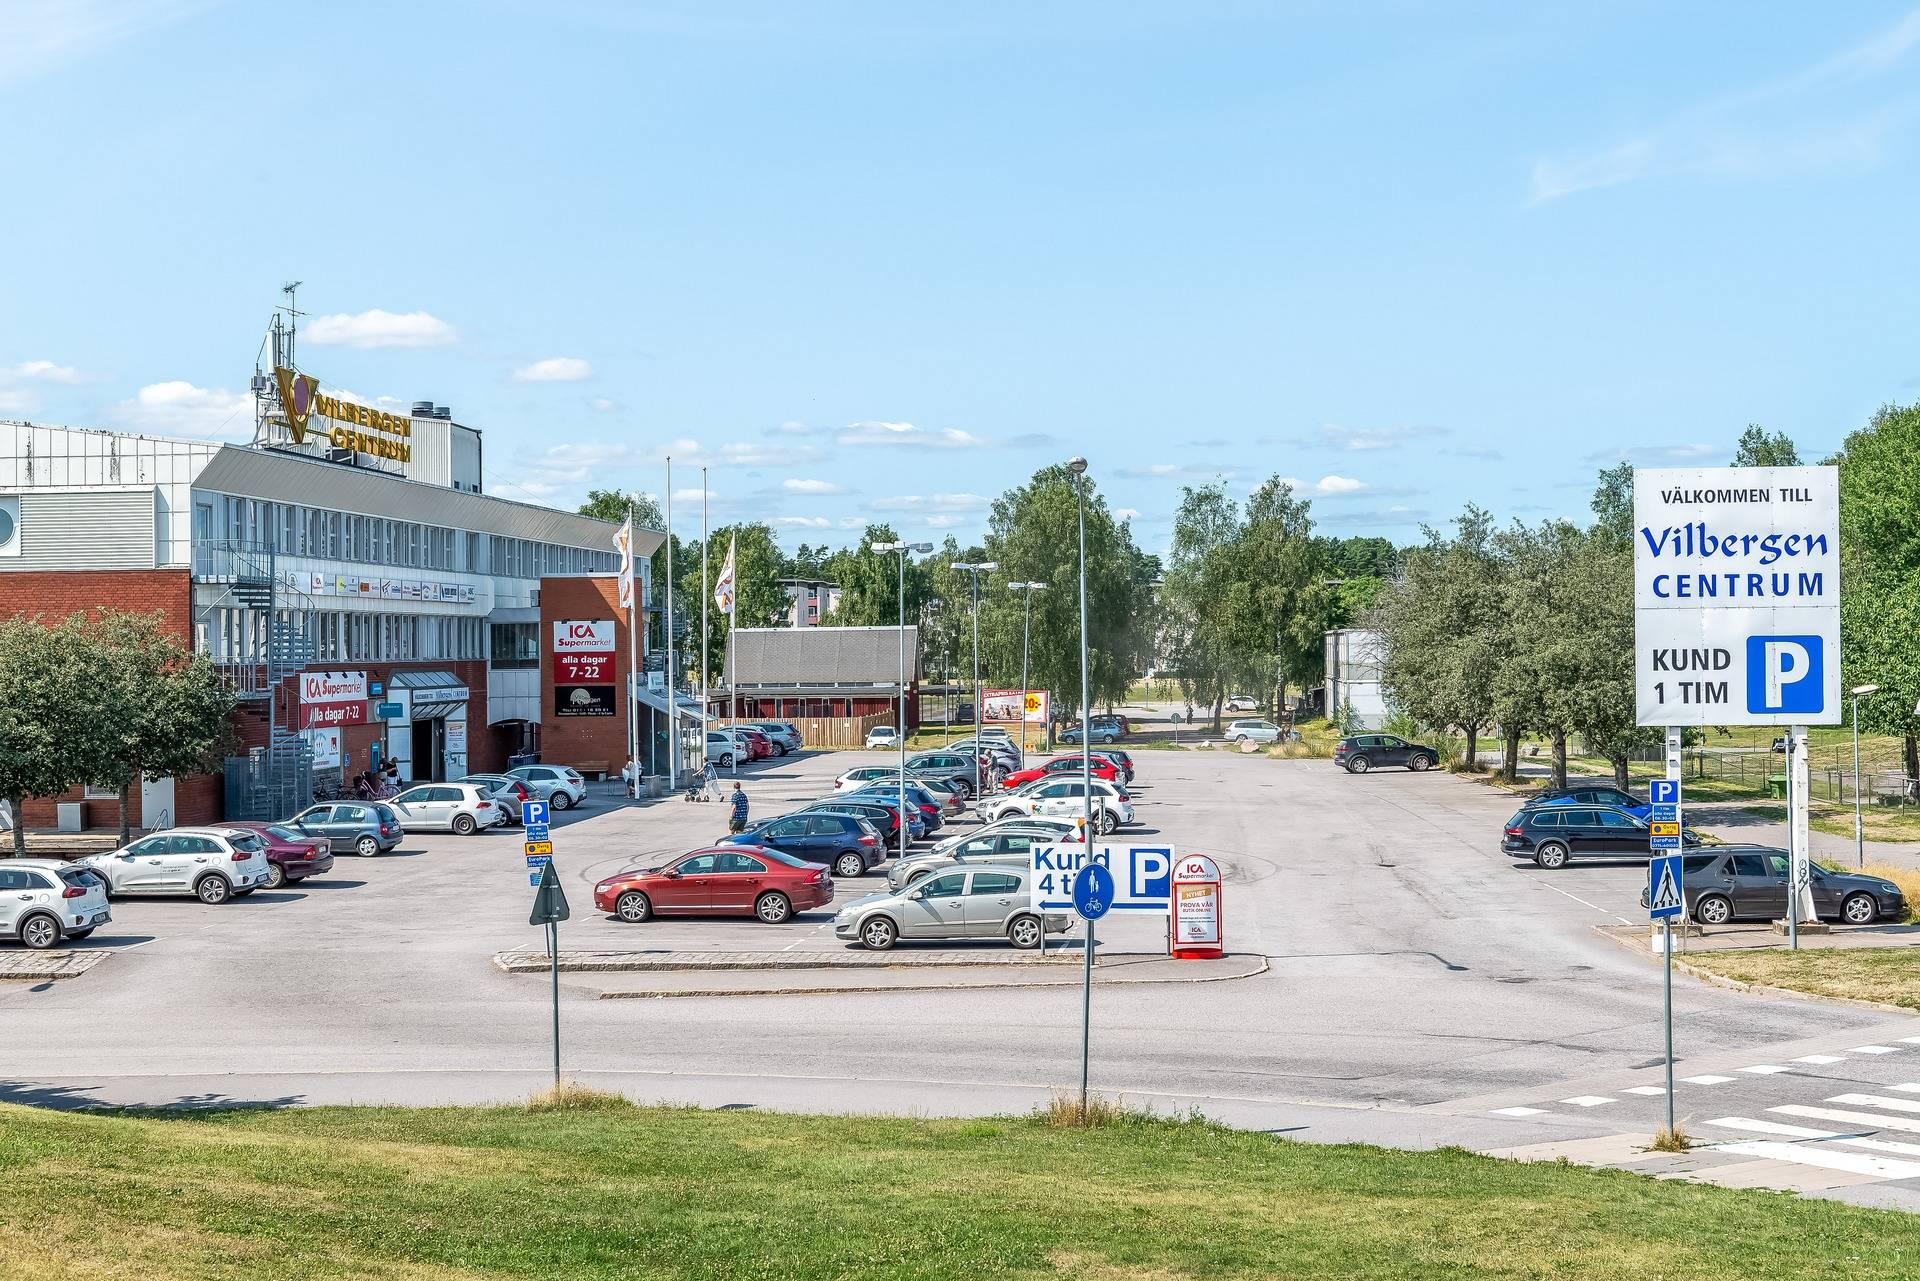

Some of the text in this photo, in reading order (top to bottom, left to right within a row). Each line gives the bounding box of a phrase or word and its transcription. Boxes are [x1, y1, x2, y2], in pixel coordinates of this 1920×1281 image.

[314, 394, 411, 437] VILBERGEN
[330, 426, 411, 463] CENTRUM
[1661, 486, 1813, 504] VÄLKOMMEN TILL
[1639, 522, 1828, 565] Vilbergen
[1652, 572, 1823, 597] CENTRUM
[569, 624, 595, 639] ICA
[558, 638, 611, 648] Supermarket
[562, 655, 608, 665] alla dagar
[1653, 641, 1811, 708] KUND P
[306, 677, 362, 698] ICA Supermarket
[1654, 681, 1729, 704] 1 TIM
[324, 706, 345, 724] dagar
[346, 705, 360, 719] 7-22
[1658, 782, 1673, 801] P
[529, 803, 543, 822] P
[1135, 852, 1169, 894] P
[1187, 864, 1204, 873] ICA
[1038, 873, 1055, 895] 4
